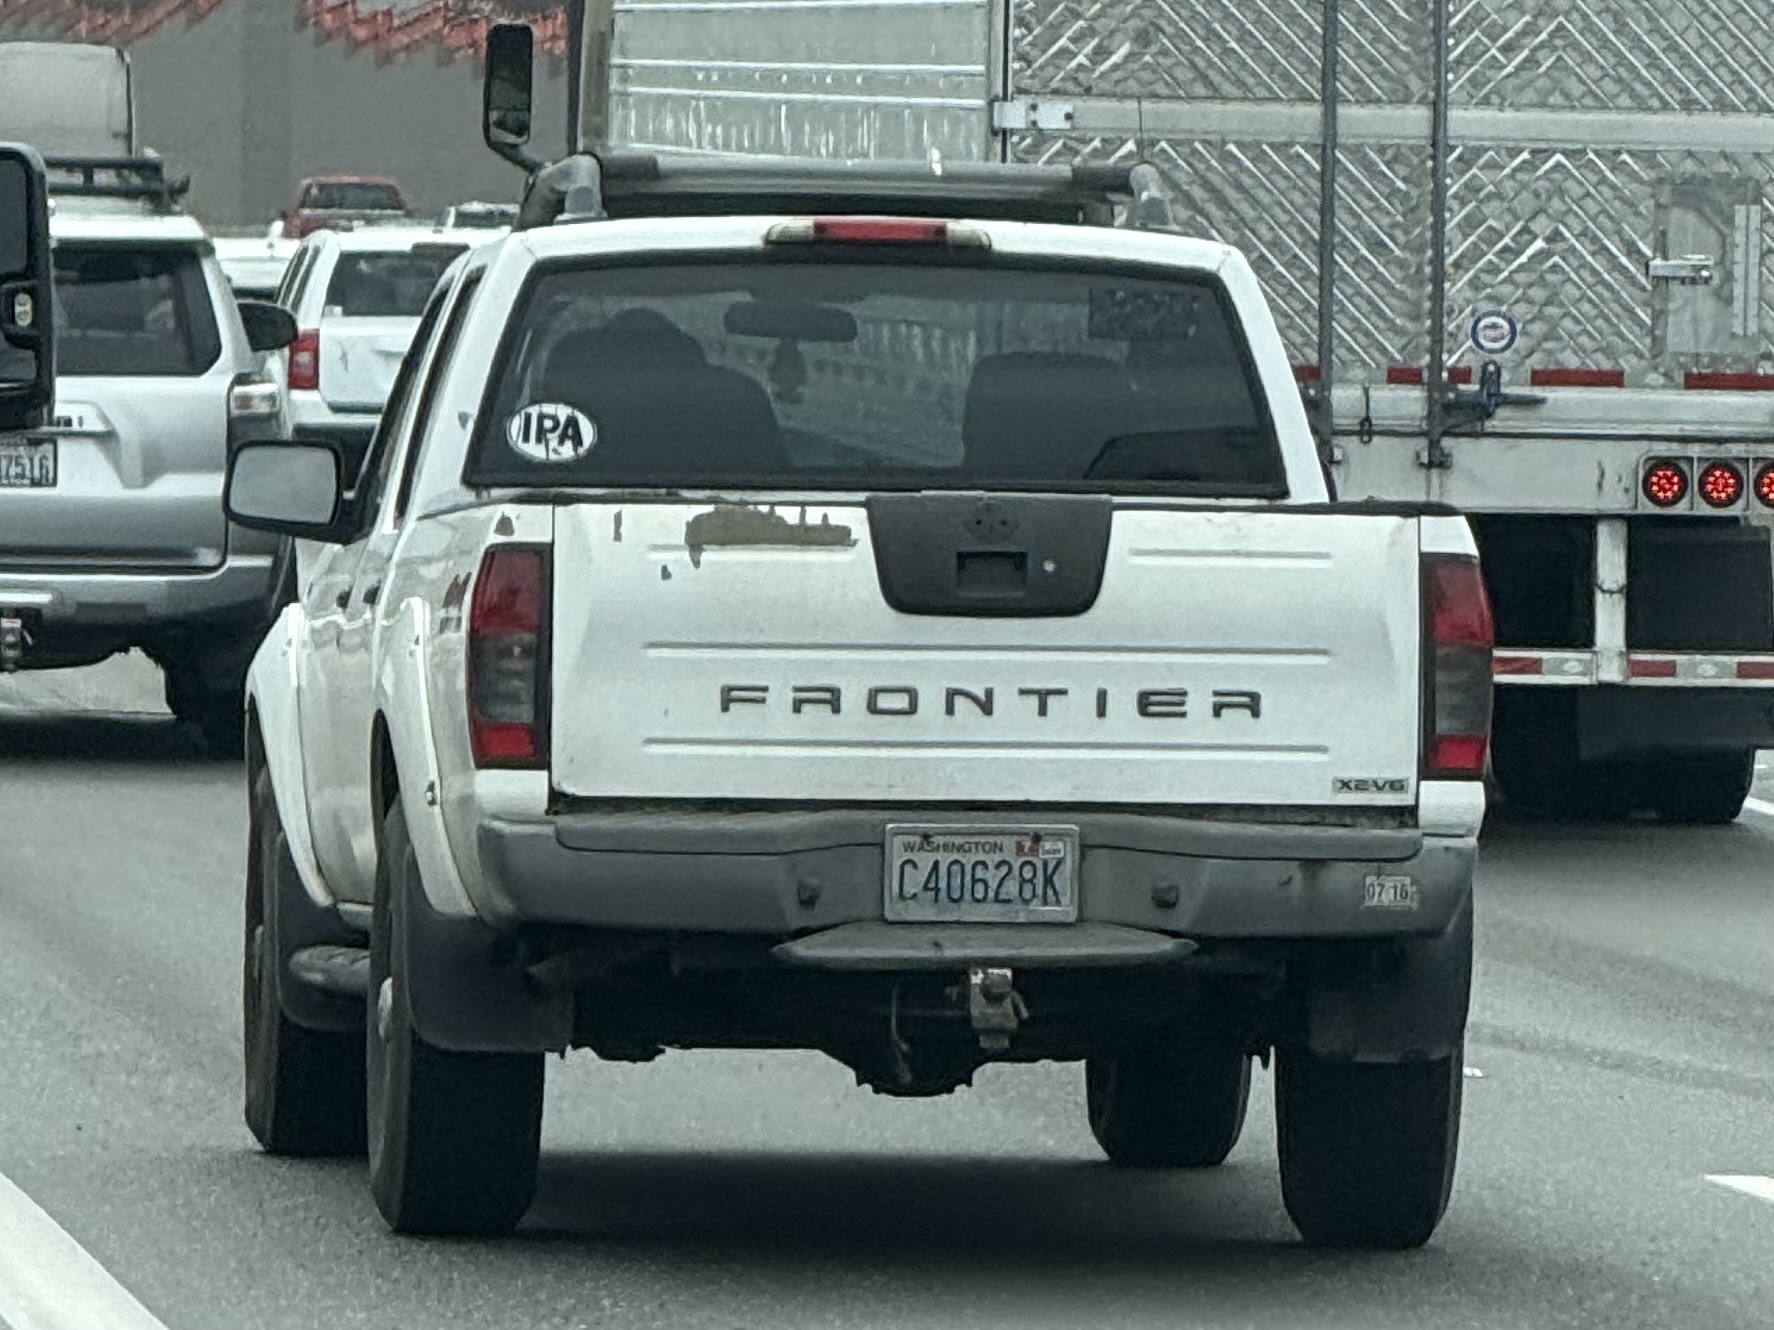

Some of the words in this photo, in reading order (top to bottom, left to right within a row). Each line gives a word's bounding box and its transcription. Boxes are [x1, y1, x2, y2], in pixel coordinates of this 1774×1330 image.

[521, 411, 583, 448] IPA
[0, 453, 49, 485] 7516
[720, 684, 1262, 719] FRONTIER
[902, 839, 1004, 853] WASHINGTON
[899, 858, 1063, 906] C40628K
[1366, 882, 1385, 900] 07
